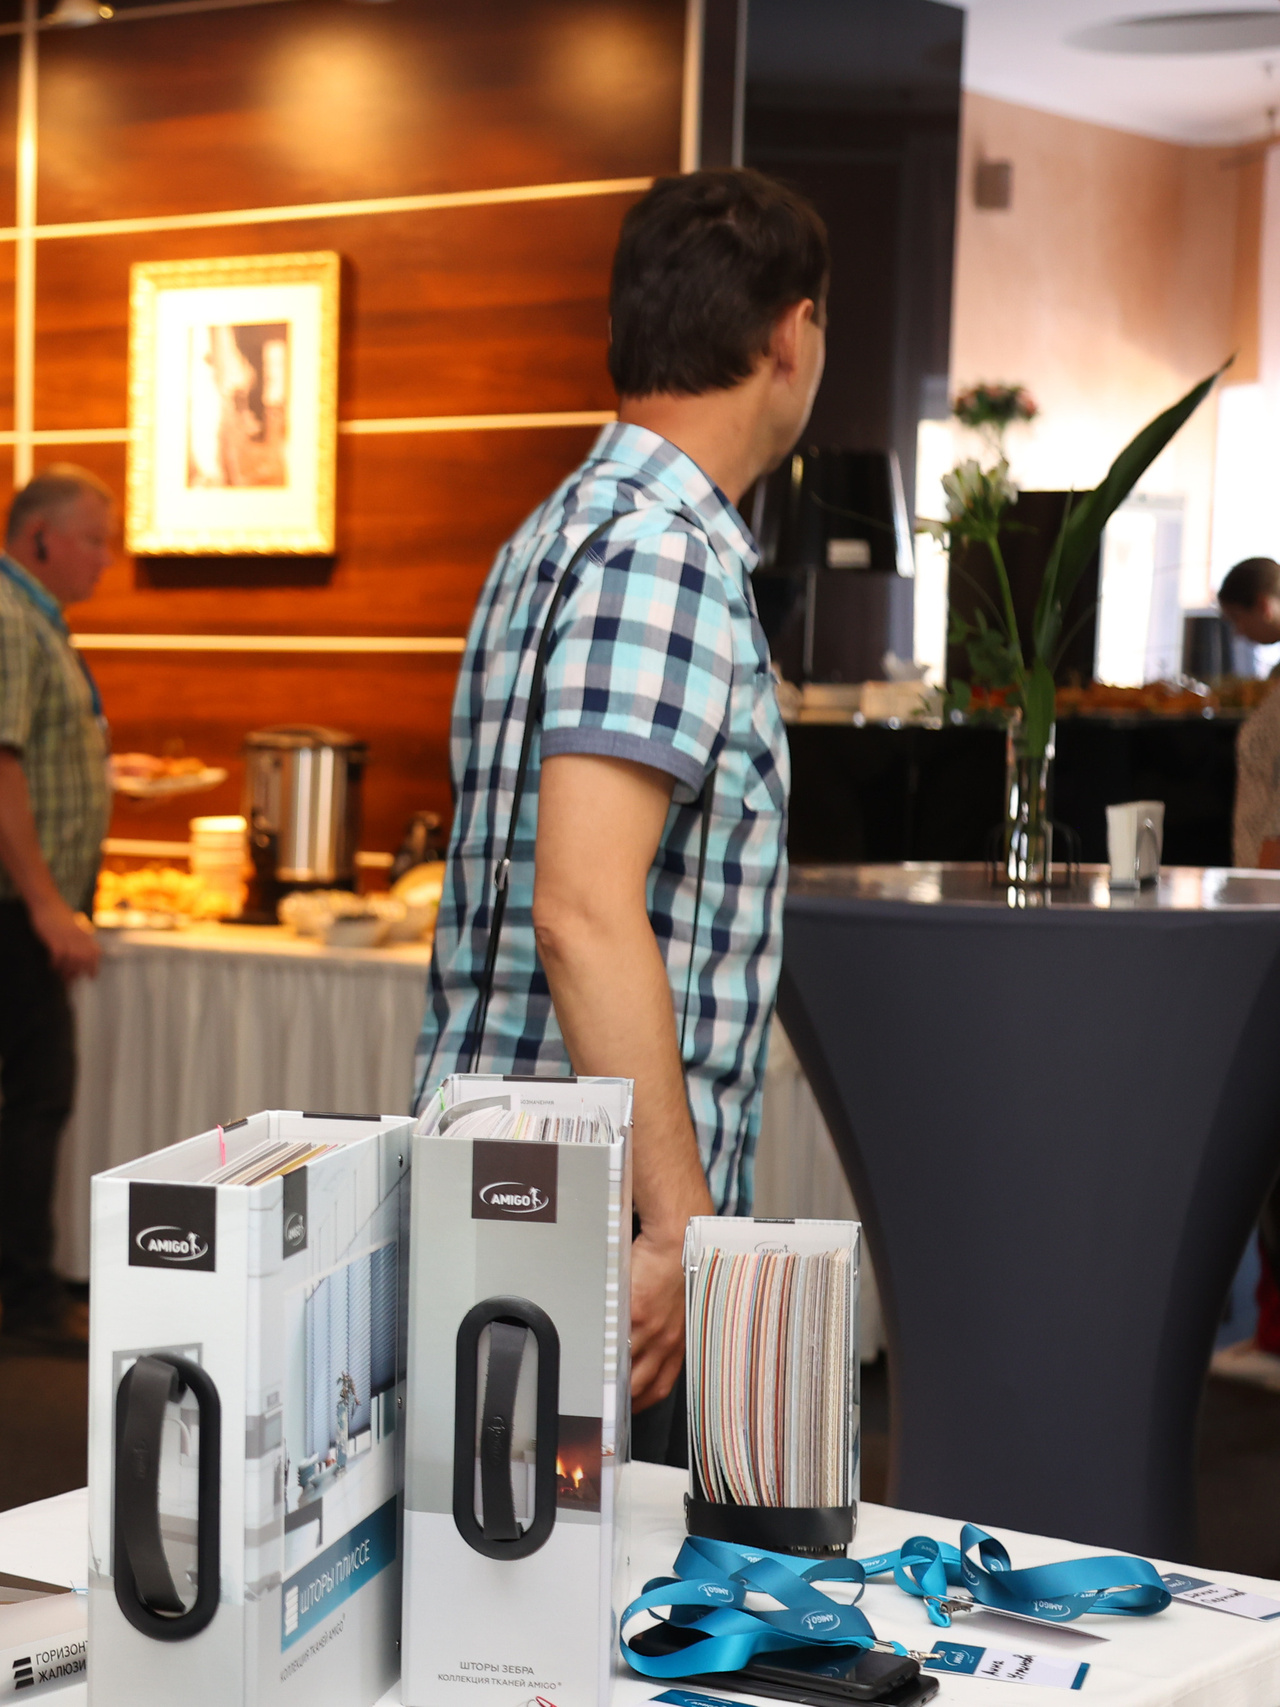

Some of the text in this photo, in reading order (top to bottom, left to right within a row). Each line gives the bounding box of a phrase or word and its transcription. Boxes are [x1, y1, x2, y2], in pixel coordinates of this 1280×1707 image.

[491, 1193, 531, 1207] AMIGO
[147, 1238, 190, 1254] AMIGO
[300, 1538, 371, 1615] ШТОРЫ ПЛИССЕ
[1039, 1600, 1064, 1611] AMIGO
[811, 1613, 834, 1625] AMIGO
[38, 1659, 87, 1683] ЖАЛЮЗИ
[460, 1661, 535, 1675] ШТОРЫ ЗЕБРА
[438, 1674, 490, 1685] КОЛЛЕКЦИЯ
[491, 1678, 525, 1688] ТКАНЕЙ
